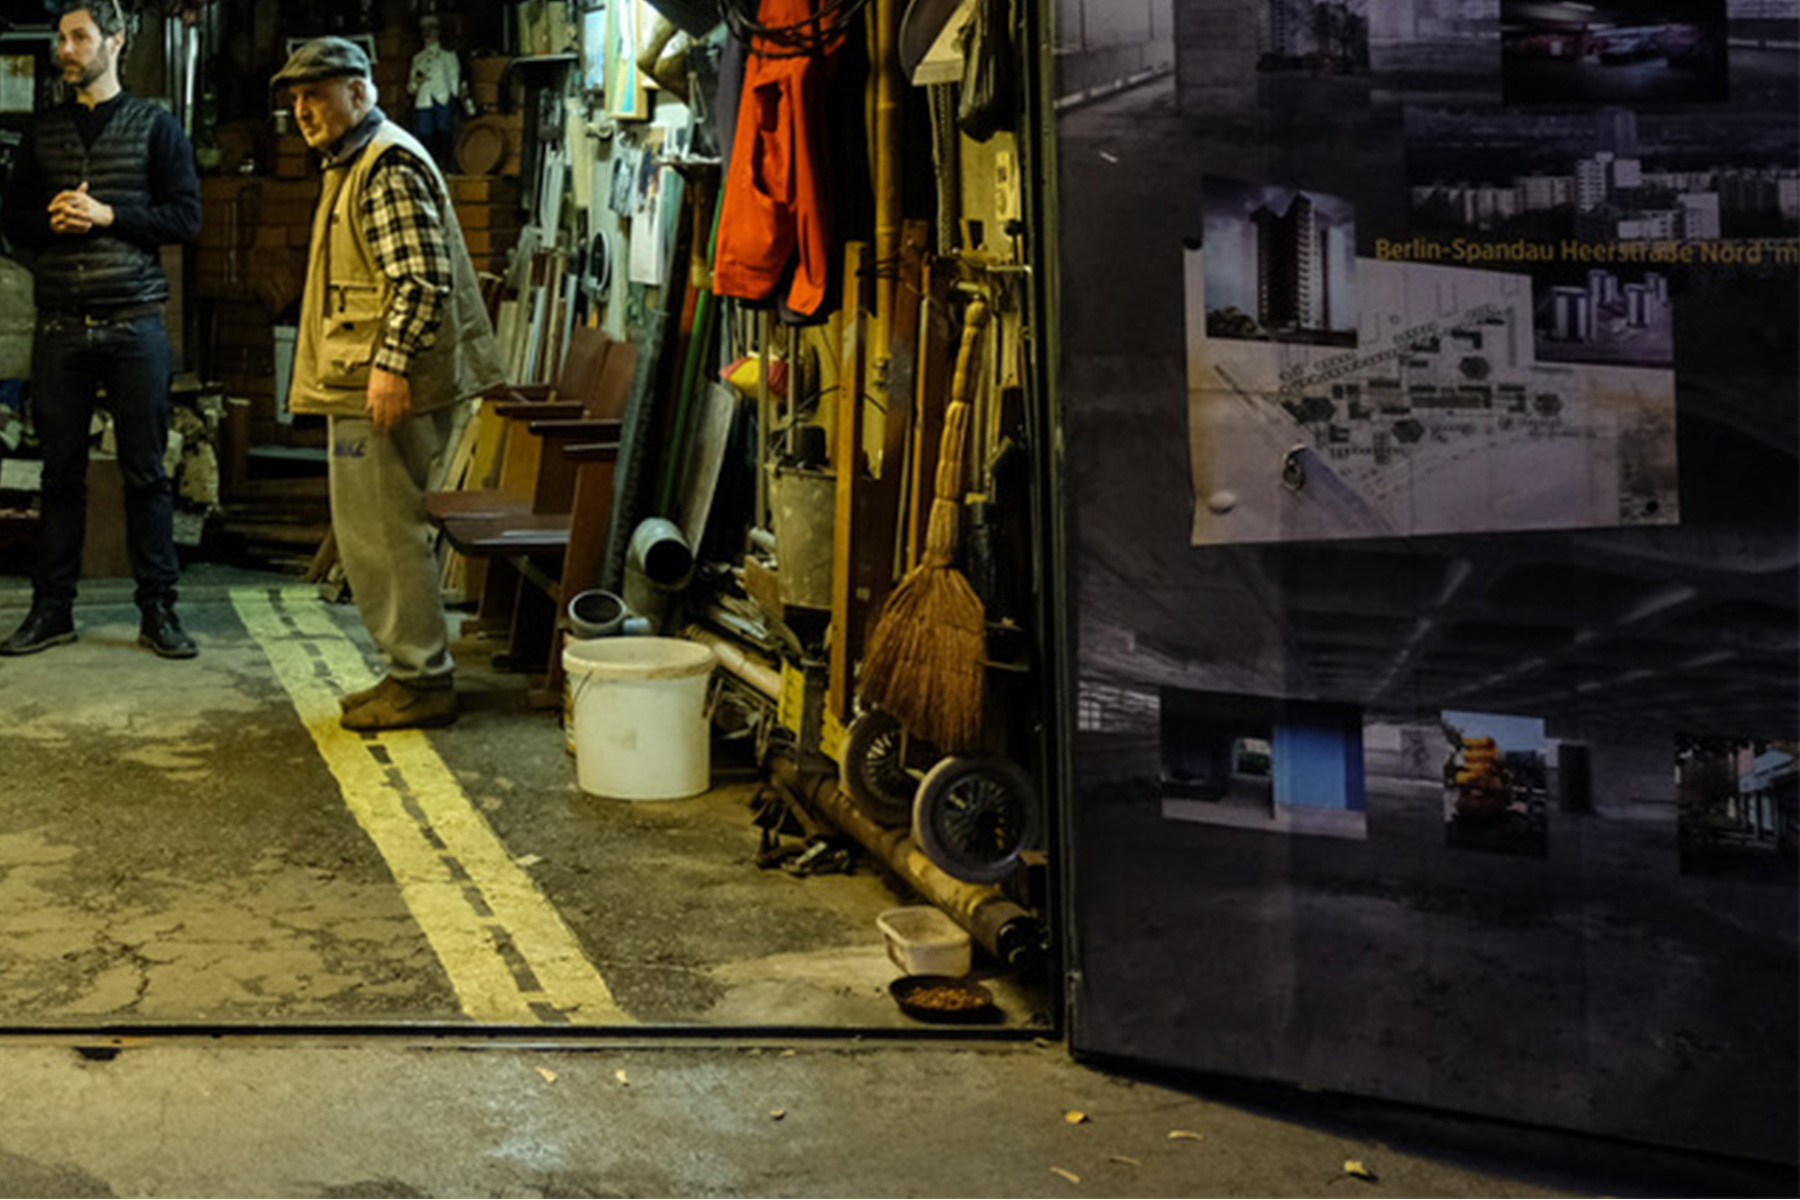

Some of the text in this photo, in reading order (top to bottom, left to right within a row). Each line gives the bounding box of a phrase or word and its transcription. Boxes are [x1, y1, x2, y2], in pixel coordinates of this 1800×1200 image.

[1374, 237, 1554, 263] Berlin-Spandau
[1560, 237, 1694, 263] Heerstraße
[1701, 240, 1763, 264] Nord
